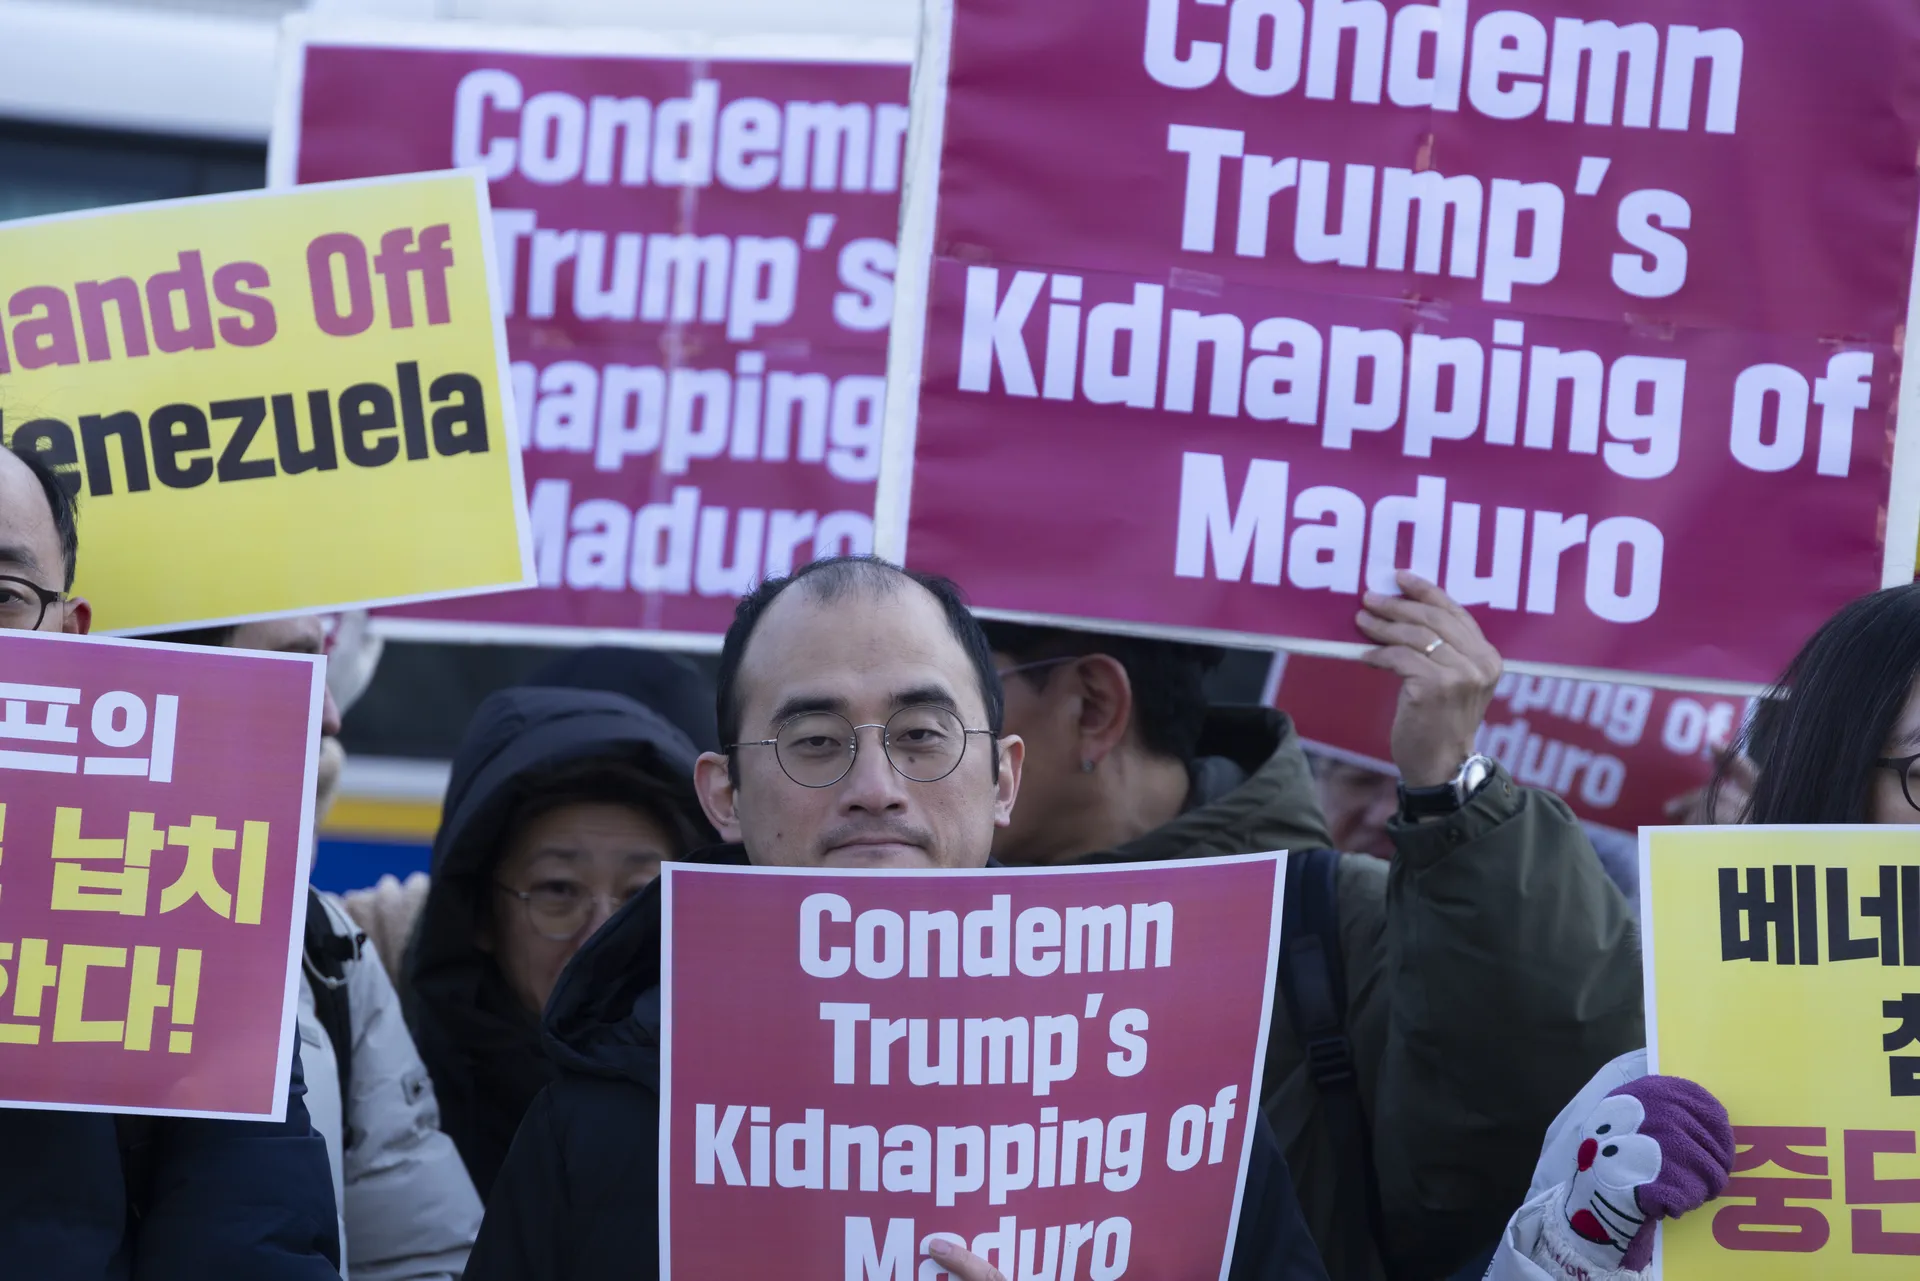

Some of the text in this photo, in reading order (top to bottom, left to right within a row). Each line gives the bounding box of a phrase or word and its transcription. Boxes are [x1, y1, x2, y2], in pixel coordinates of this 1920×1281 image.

[1144, 0, 1744, 134] Condemn
[1167, 123, 1692, 303] Trump's
[0, 223, 455, 374] ands Off
[0, 361, 489, 497] enezuela
[957, 265, 1874, 480] Kidnapping of
[1174, 450, 1664, 625] Maduro
[1474, 718, 1626, 809] duro
[1661, 697, 1735, 761] of
[51, 806, 270, 926] 납치
[1718, 864, 1920, 966] 베네
[799, 892, 1174, 980] Condemn
[819, 993, 1149, 1096] Trump's
[695, 1084, 1238, 1207] Kidnapping of
